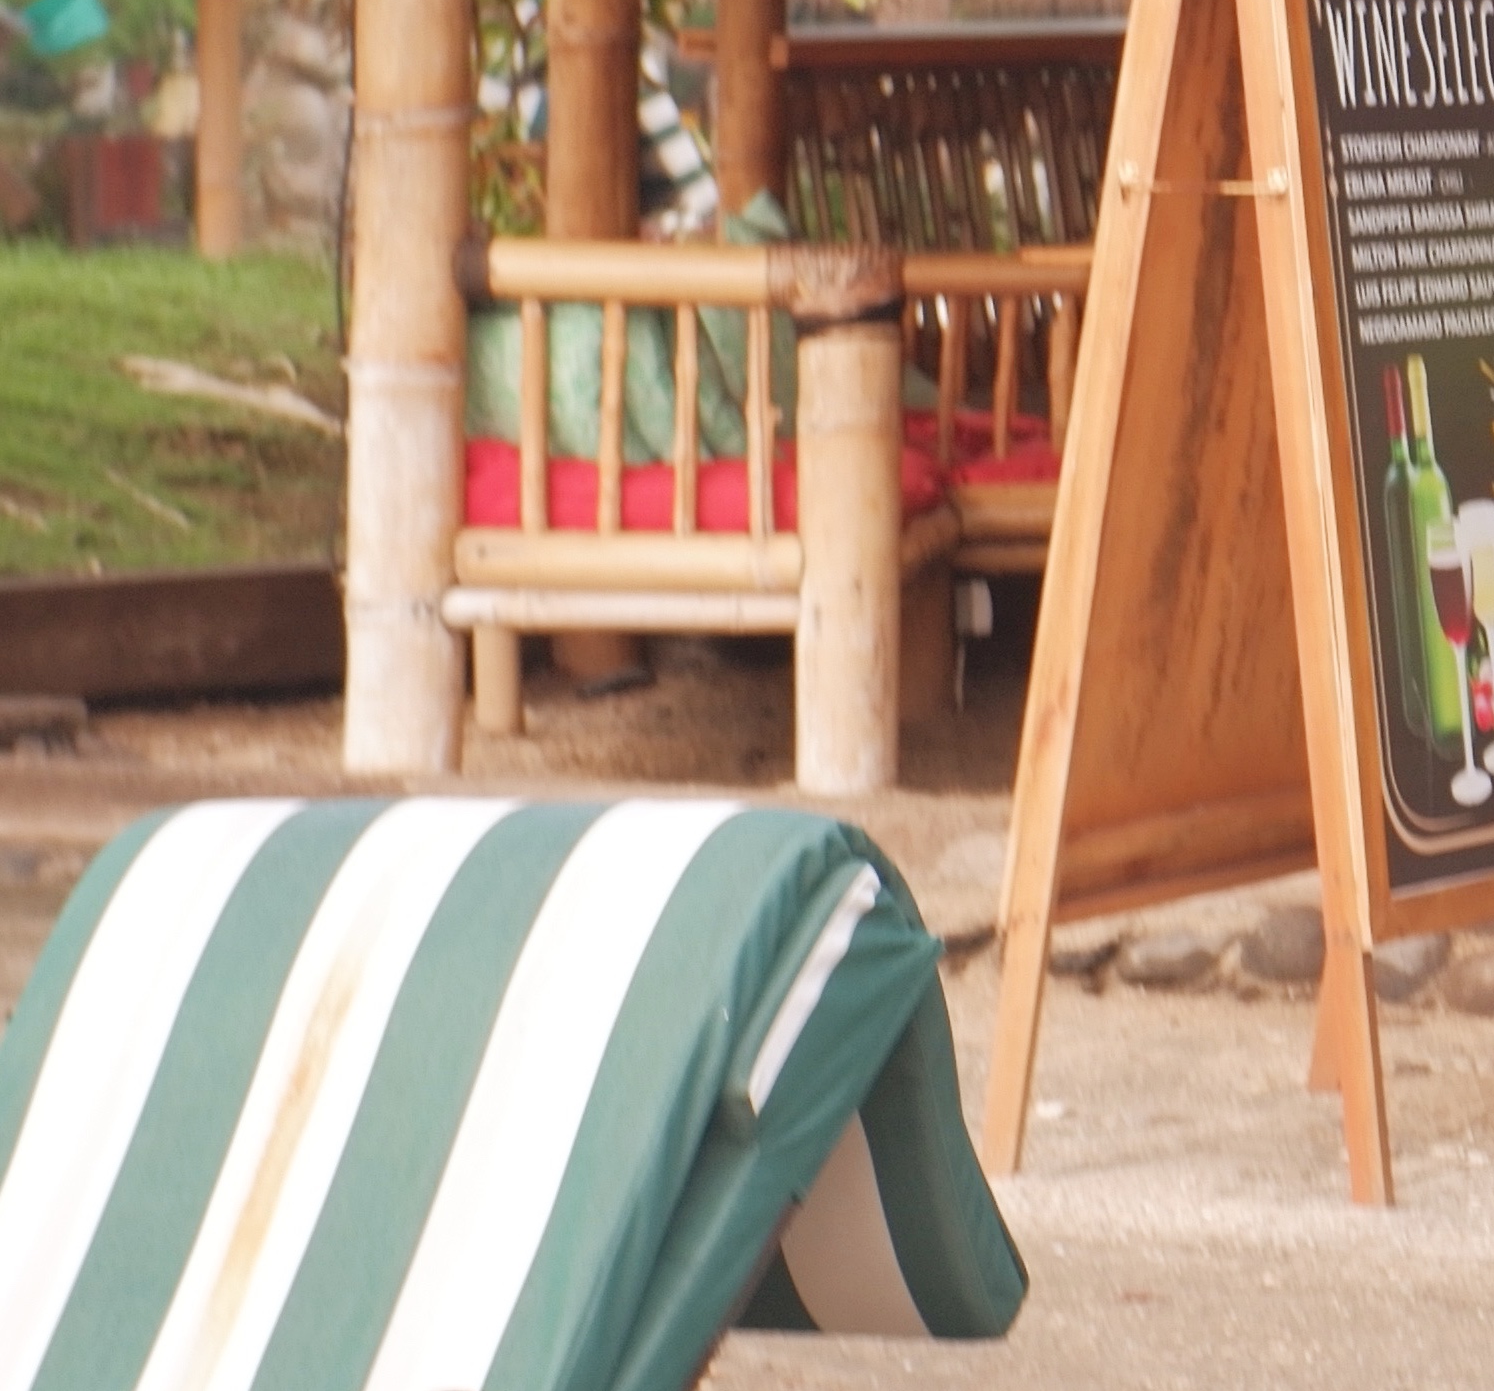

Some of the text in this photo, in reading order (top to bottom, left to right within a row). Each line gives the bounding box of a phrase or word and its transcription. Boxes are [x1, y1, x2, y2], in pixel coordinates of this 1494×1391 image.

[1403, 129, 1480, 161] CHARDONNAY
[1386, 166, 1431, 197] MERLOT
[1352, 240, 1398, 273] MILTON
[1397, 238, 1429, 270] PARK
[1380, 275, 1418, 307] FELIPE
